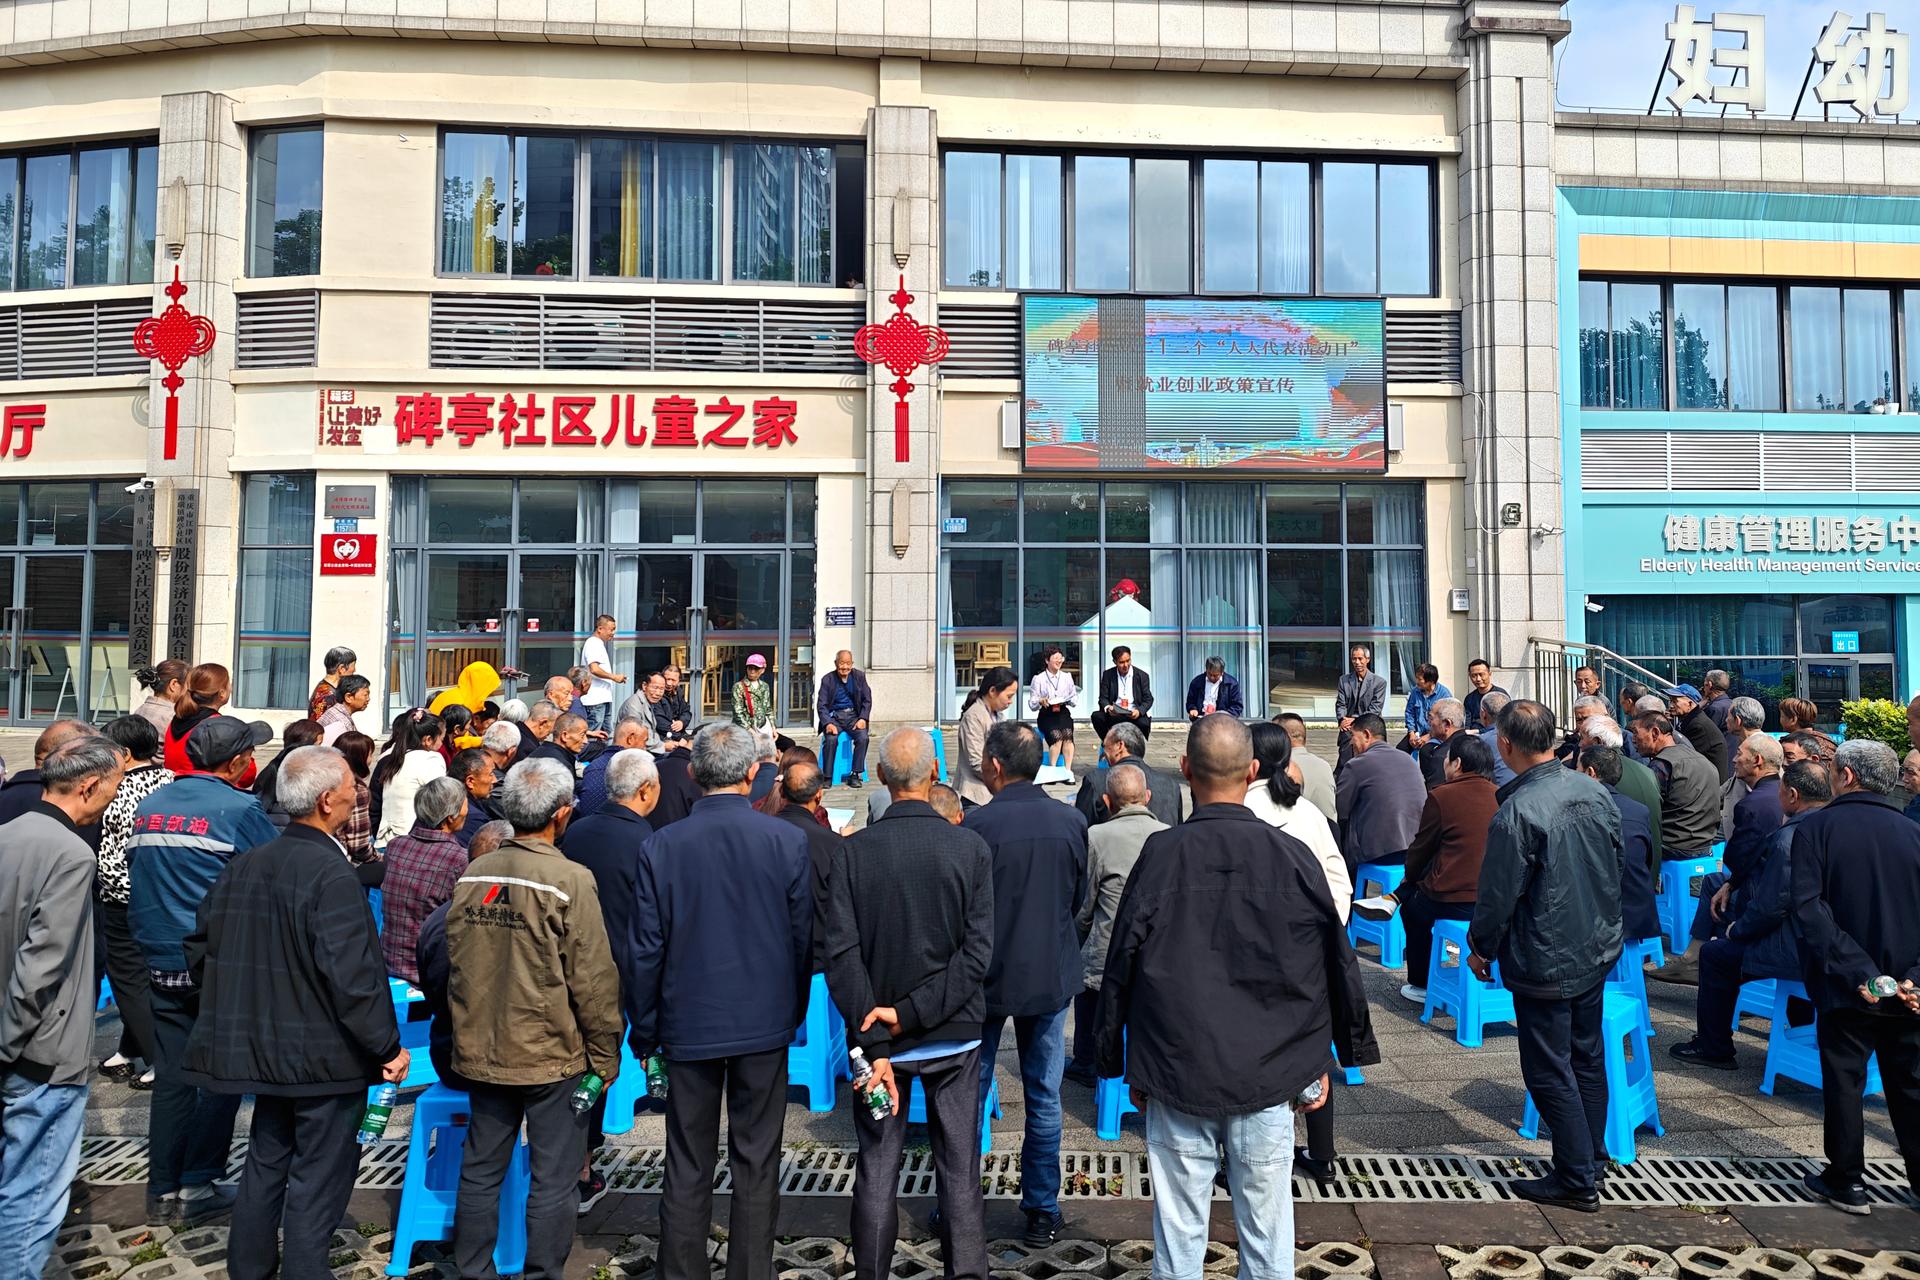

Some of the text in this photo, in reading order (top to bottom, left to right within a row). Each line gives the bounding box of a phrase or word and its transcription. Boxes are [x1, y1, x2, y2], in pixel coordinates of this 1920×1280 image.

[1665, 4, 1910, 116] 妇幼
[330, 390, 353, 402] 福彩
[327, 406, 382, 426] 让美好
[395, 392, 798, 448] 碑亭社区儿童之家
[0, 404, 47, 459] 厅
[326, 426, 362, 446] 发生
[1664, 513, 1920, 553] 健康管理服务中
[1640, 557, 1698, 575] Elderly
[1701, 556, 1754, 573] Health
[1757, 558, 1862, 576] Management
[133, 549, 153, 665] 碑亭社区居民委员会
[1836, 640, 1856, 651] 出口
[134, 813, 210, 836] 中国航油
